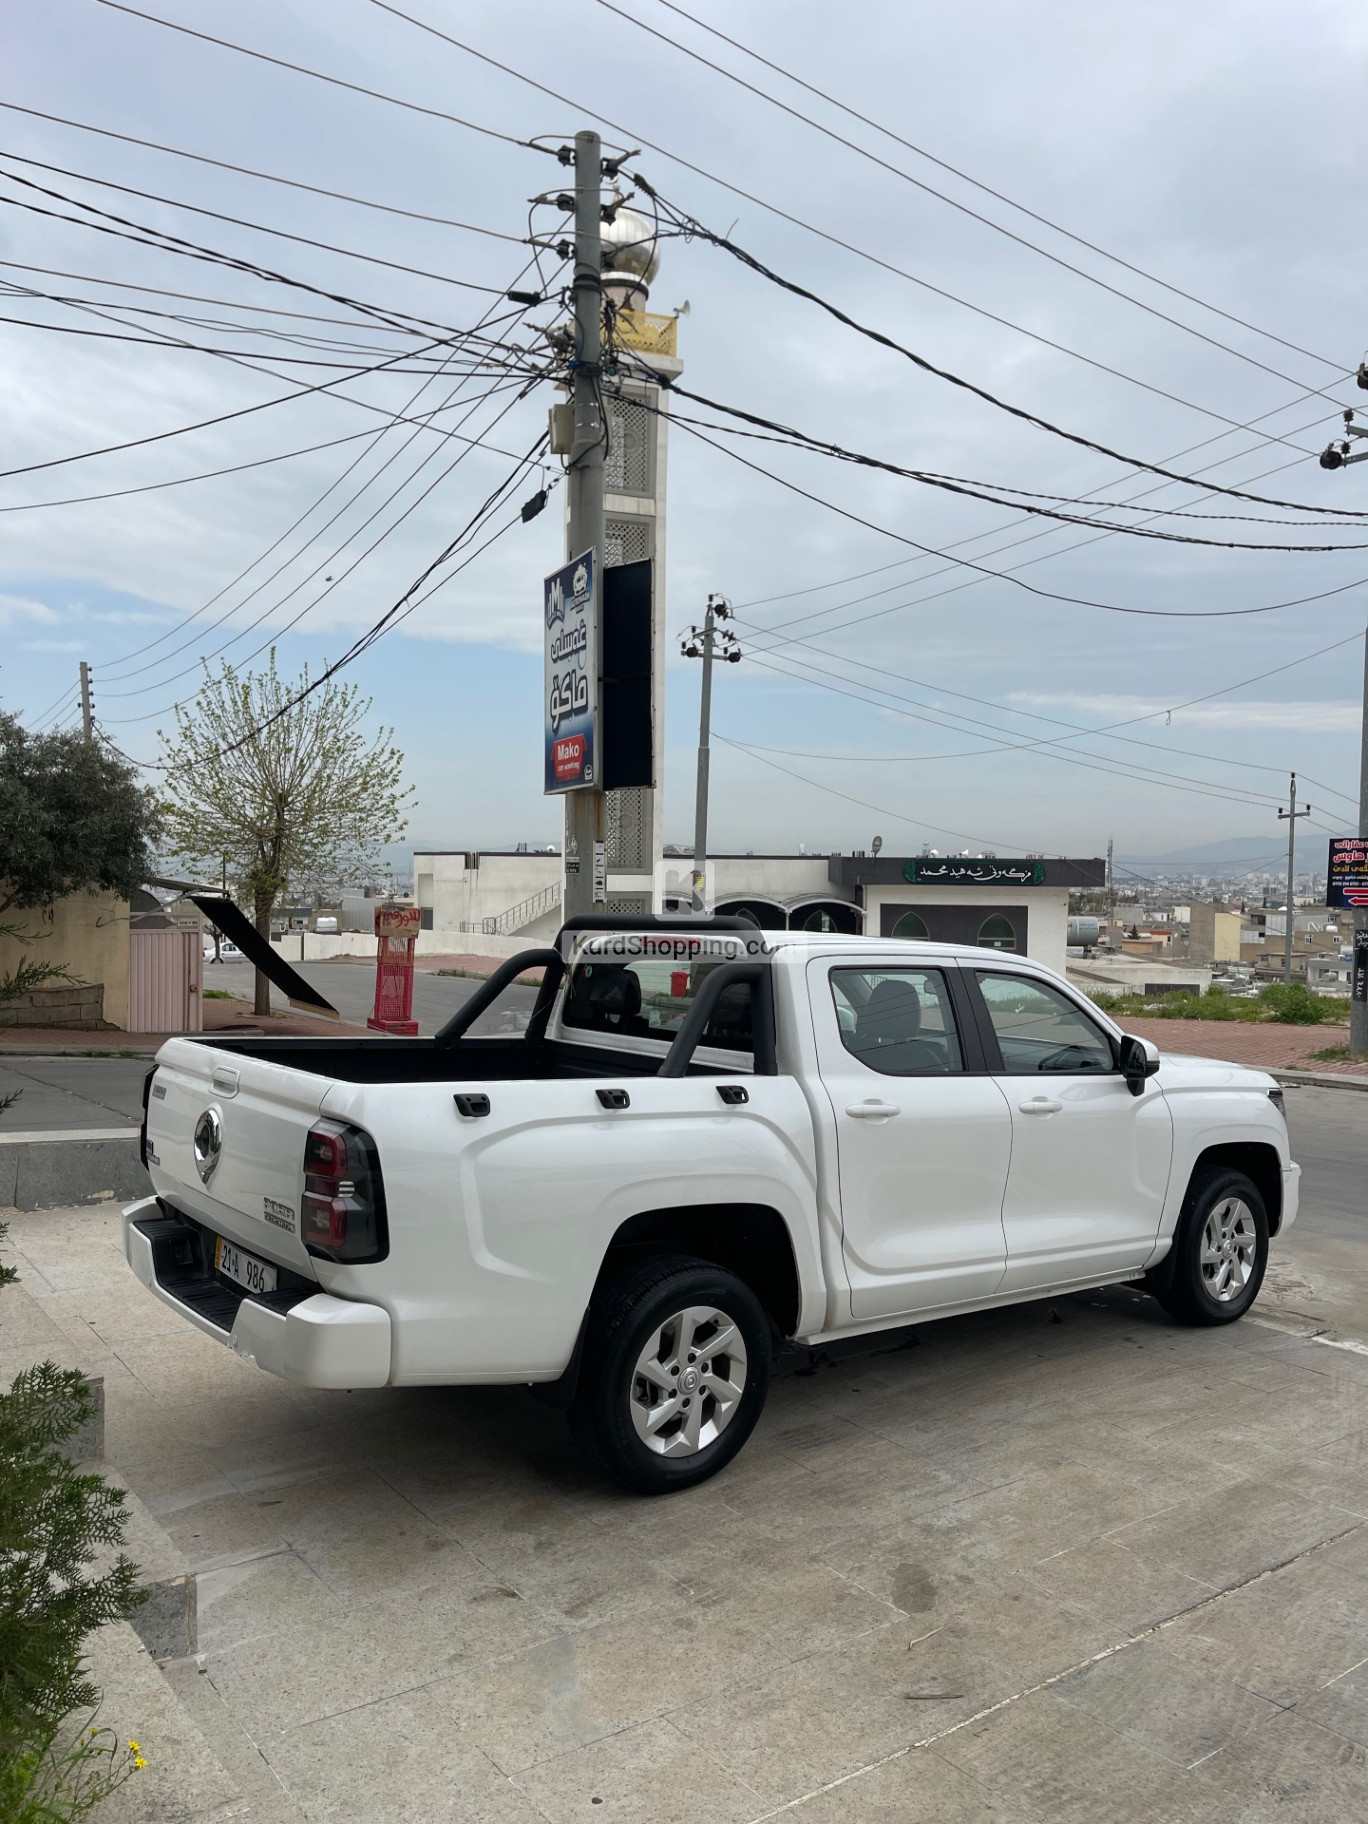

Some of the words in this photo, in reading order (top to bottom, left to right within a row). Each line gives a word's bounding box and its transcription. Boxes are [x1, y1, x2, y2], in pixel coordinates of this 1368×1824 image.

[557, 742, 580, 760] Mako
[920, 865, 948, 876] محمد
[246, 1260, 265, 1293] 986
